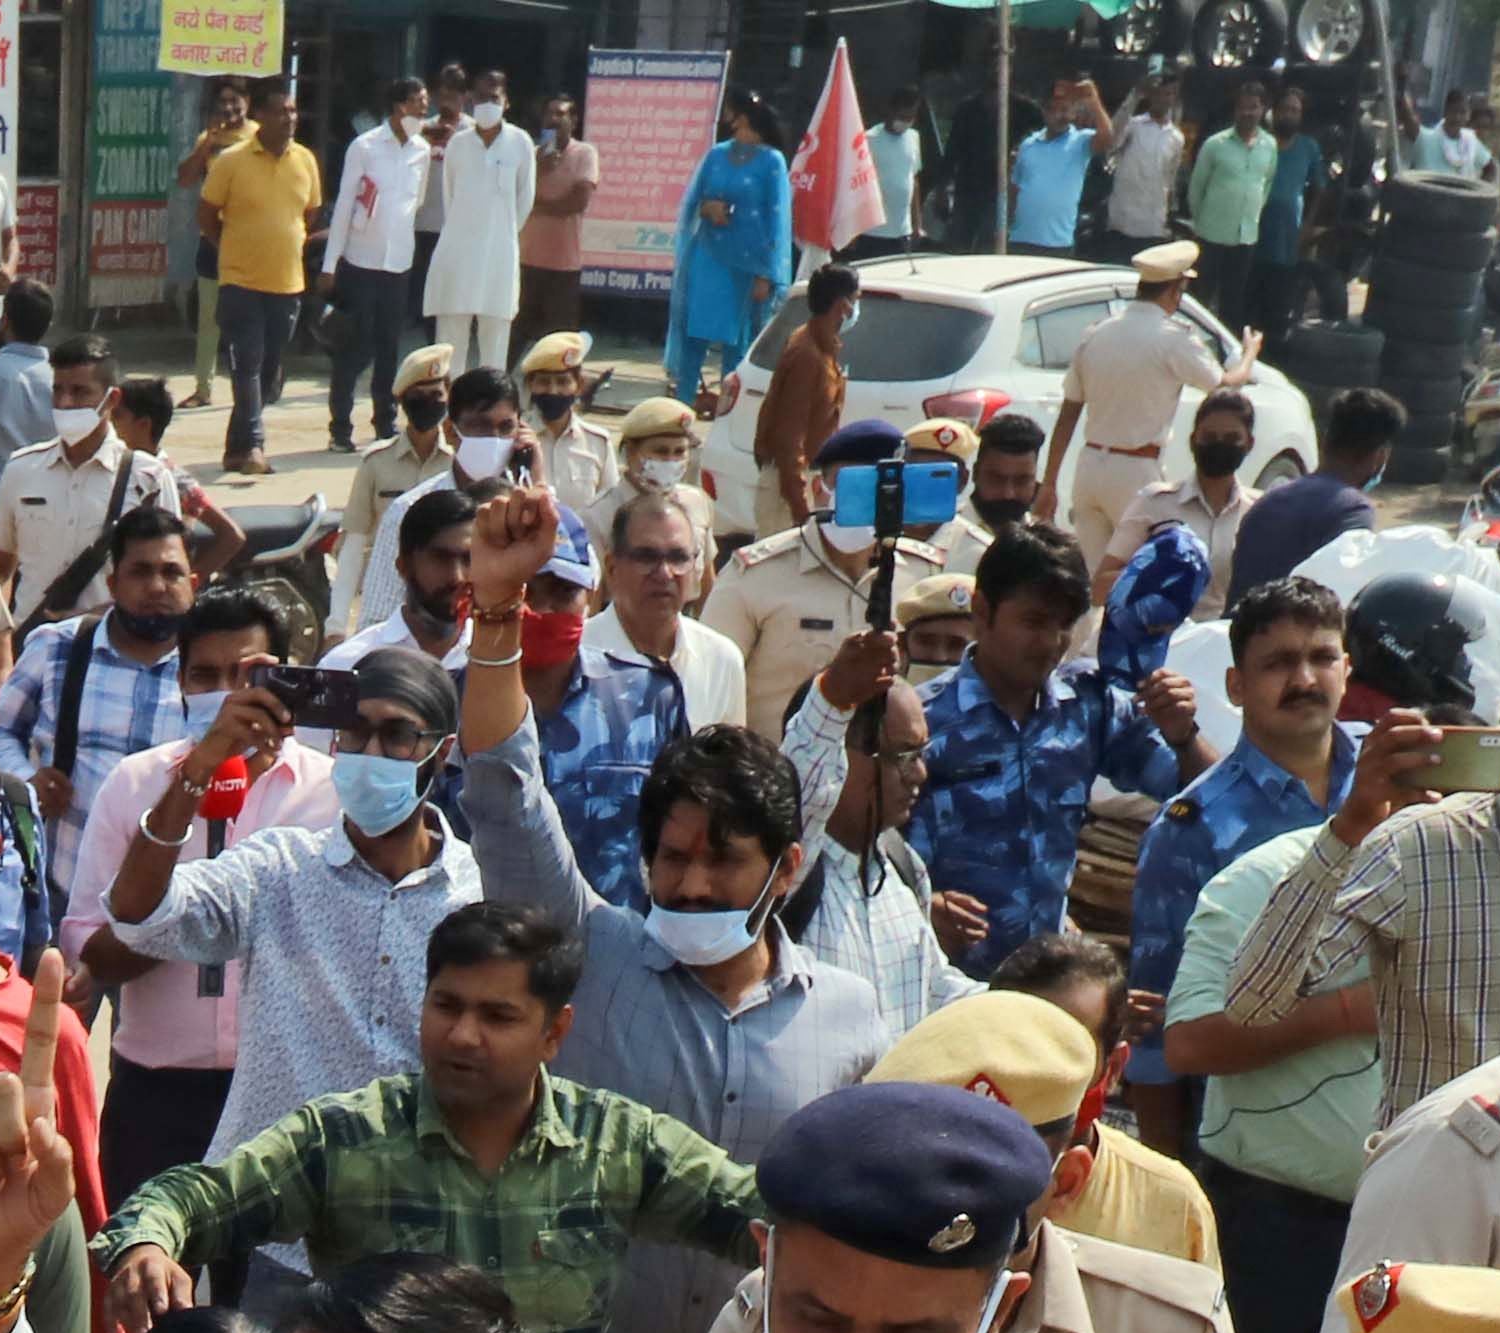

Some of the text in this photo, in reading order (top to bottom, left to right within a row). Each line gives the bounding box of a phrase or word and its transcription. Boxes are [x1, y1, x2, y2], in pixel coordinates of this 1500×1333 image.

[589, 57, 722, 77] Jagdish Communication
[96, 146, 168, 194] ZOMATO
[92, 208, 125, 247] PAN
